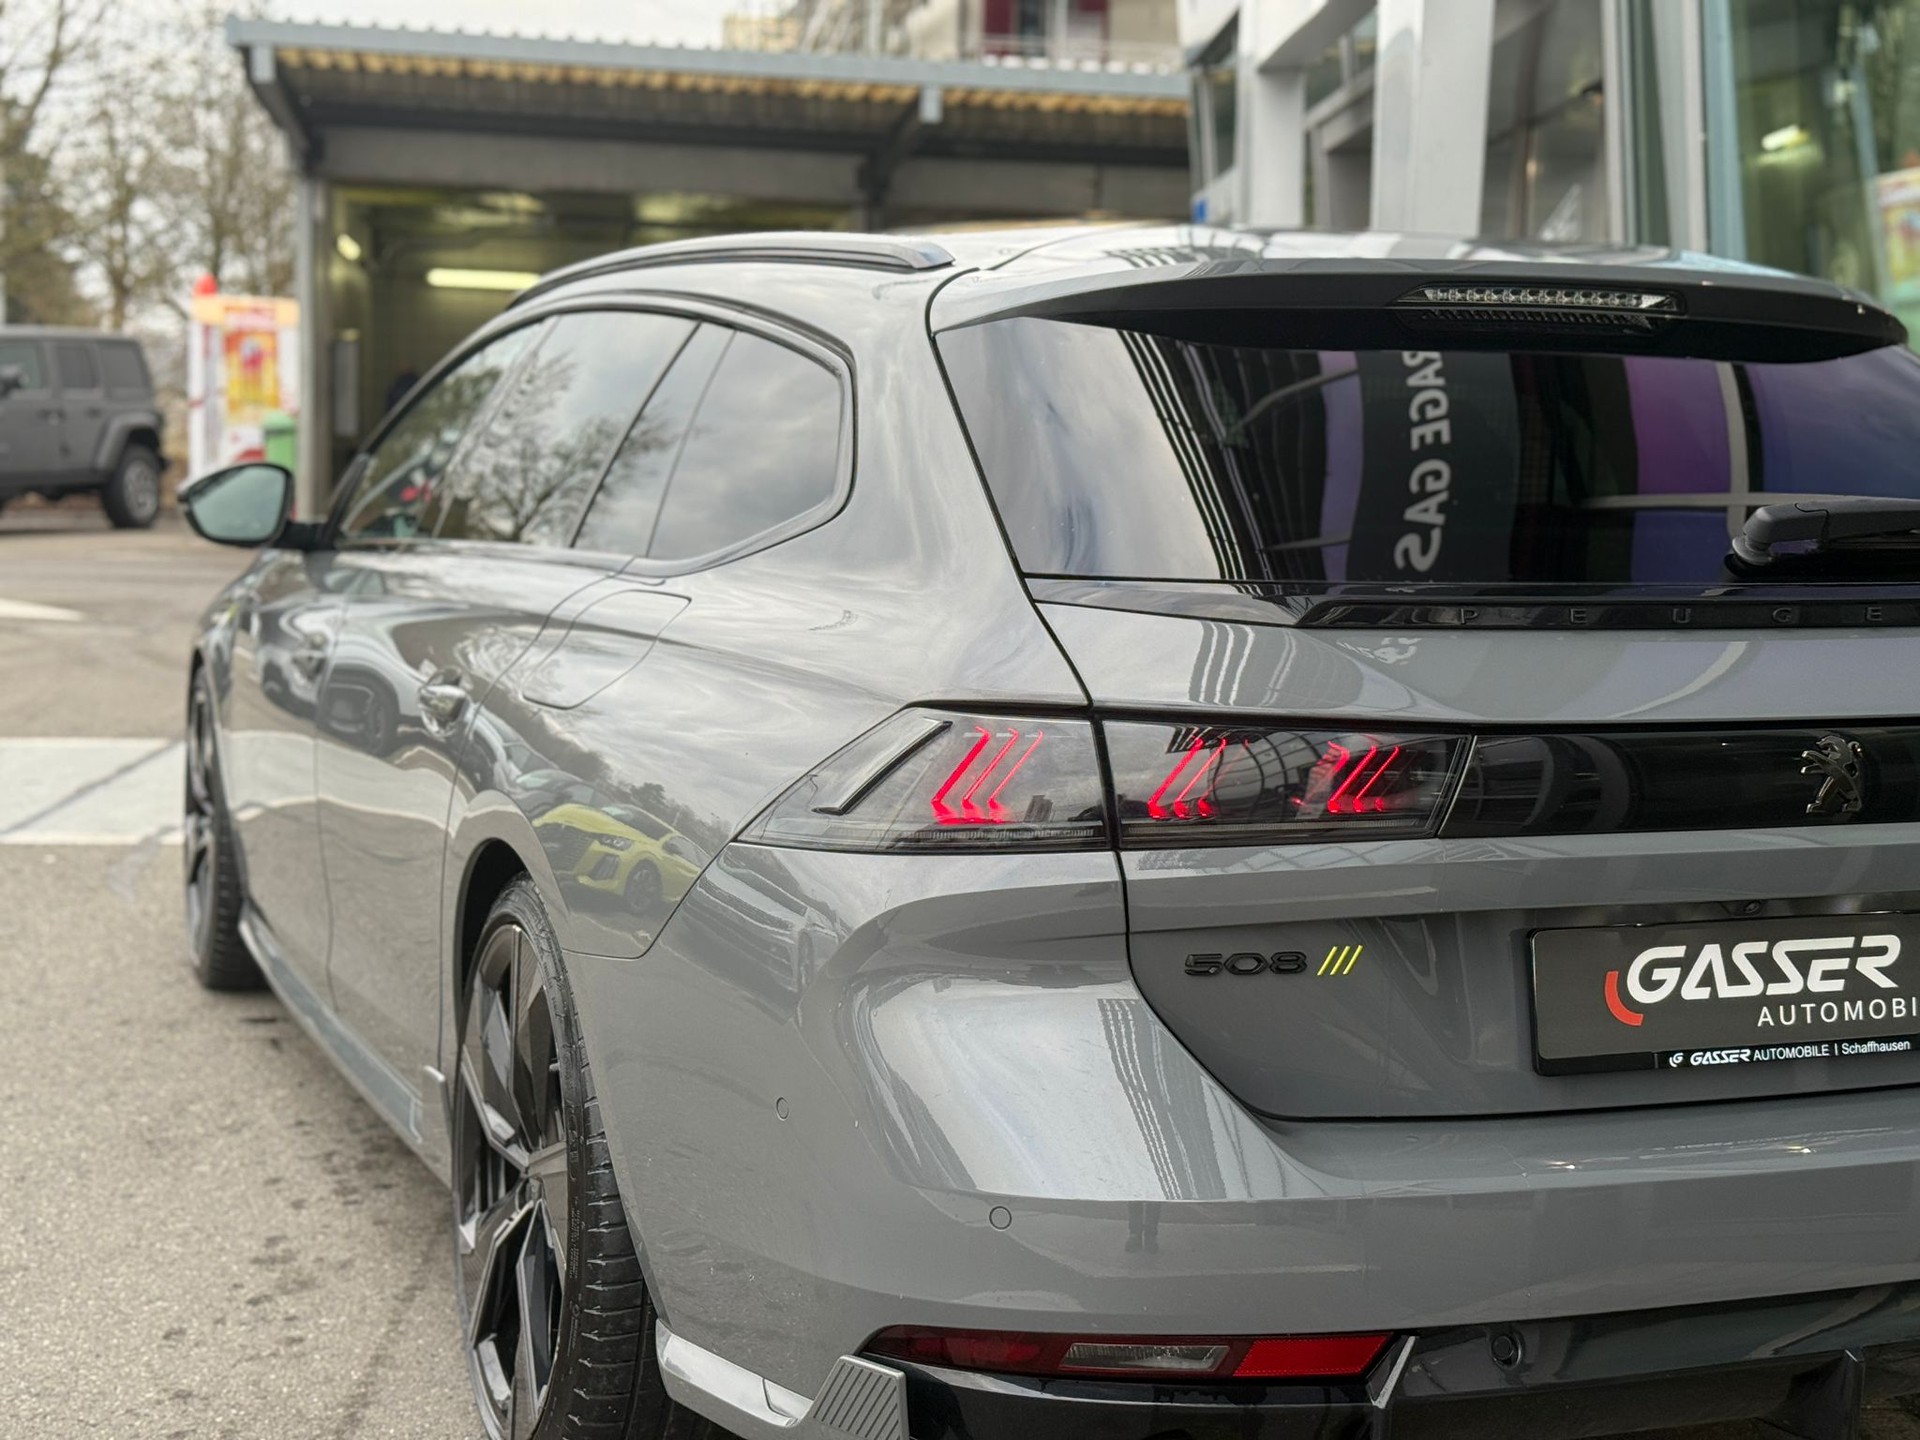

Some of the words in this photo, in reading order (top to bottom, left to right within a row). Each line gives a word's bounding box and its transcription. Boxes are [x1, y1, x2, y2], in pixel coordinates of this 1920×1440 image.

[1184, 951, 1308, 976] 508
[1626, 934, 1901, 1004] GASSER
[1757, 997, 1918, 1027] AUTOMOBI
[1690, 1049, 1751, 1066] GASSER
[1753, 1044, 1830, 1062] AUTOMOBILE
[1841, 1040, 1911, 1055] Schaffhausen
